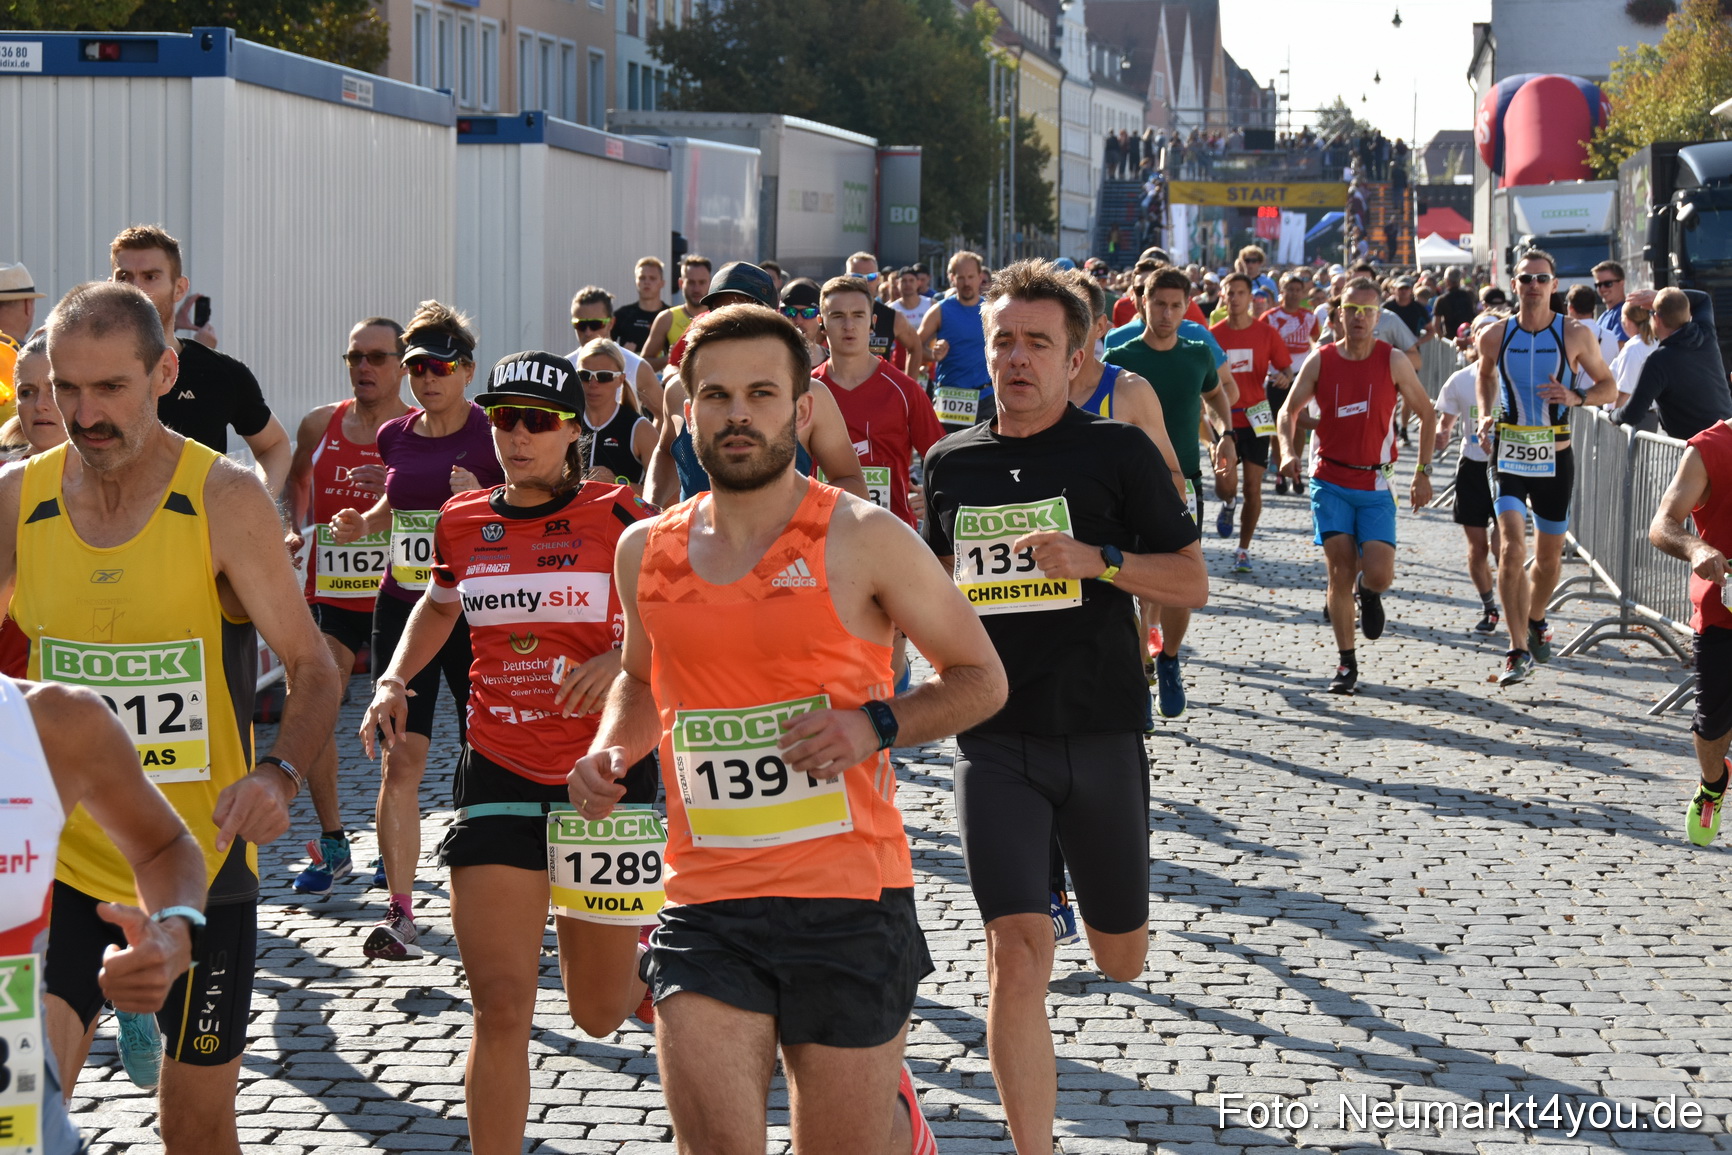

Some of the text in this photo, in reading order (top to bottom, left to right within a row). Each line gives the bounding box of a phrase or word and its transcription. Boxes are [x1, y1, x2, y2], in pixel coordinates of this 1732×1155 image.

[1227, 187, 1288, 202] START
[493, 360, 569, 392] OAKLEY
[942, 400, 973, 413] 1078
[1505, 430, 1547, 441] BOCK
[1505, 444, 1548, 461] 2590
[1504, 462, 1549, 471] REINHARD
[962, 508, 1055, 533] BOCK
[401, 538, 434, 562] 10
[531, 541, 570, 551] SCHLENK
[324, 551, 385, 572] 1162
[968, 543, 1037, 576] 133
[329, 578, 379, 589] JÜRGEN
[771, 575, 817, 588] adidas
[463, 586, 589, 613] twenty.six
[967, 581, 1067, 602] CHRISTIAN
[54, 647, 188, 680] BOCK
[481, 673, 552, 686] Vermögensber
[191, 694, 199, 702] A
[510, 688, 531, 697] Oliver
[138, 749, 176, 766] AS
[560, 817, 659, 838] BOCK
[564, 850, 662, 886] 1289
[584, 896, 644, 911] VIOLA
[20, 1038, 31, 1049] A
